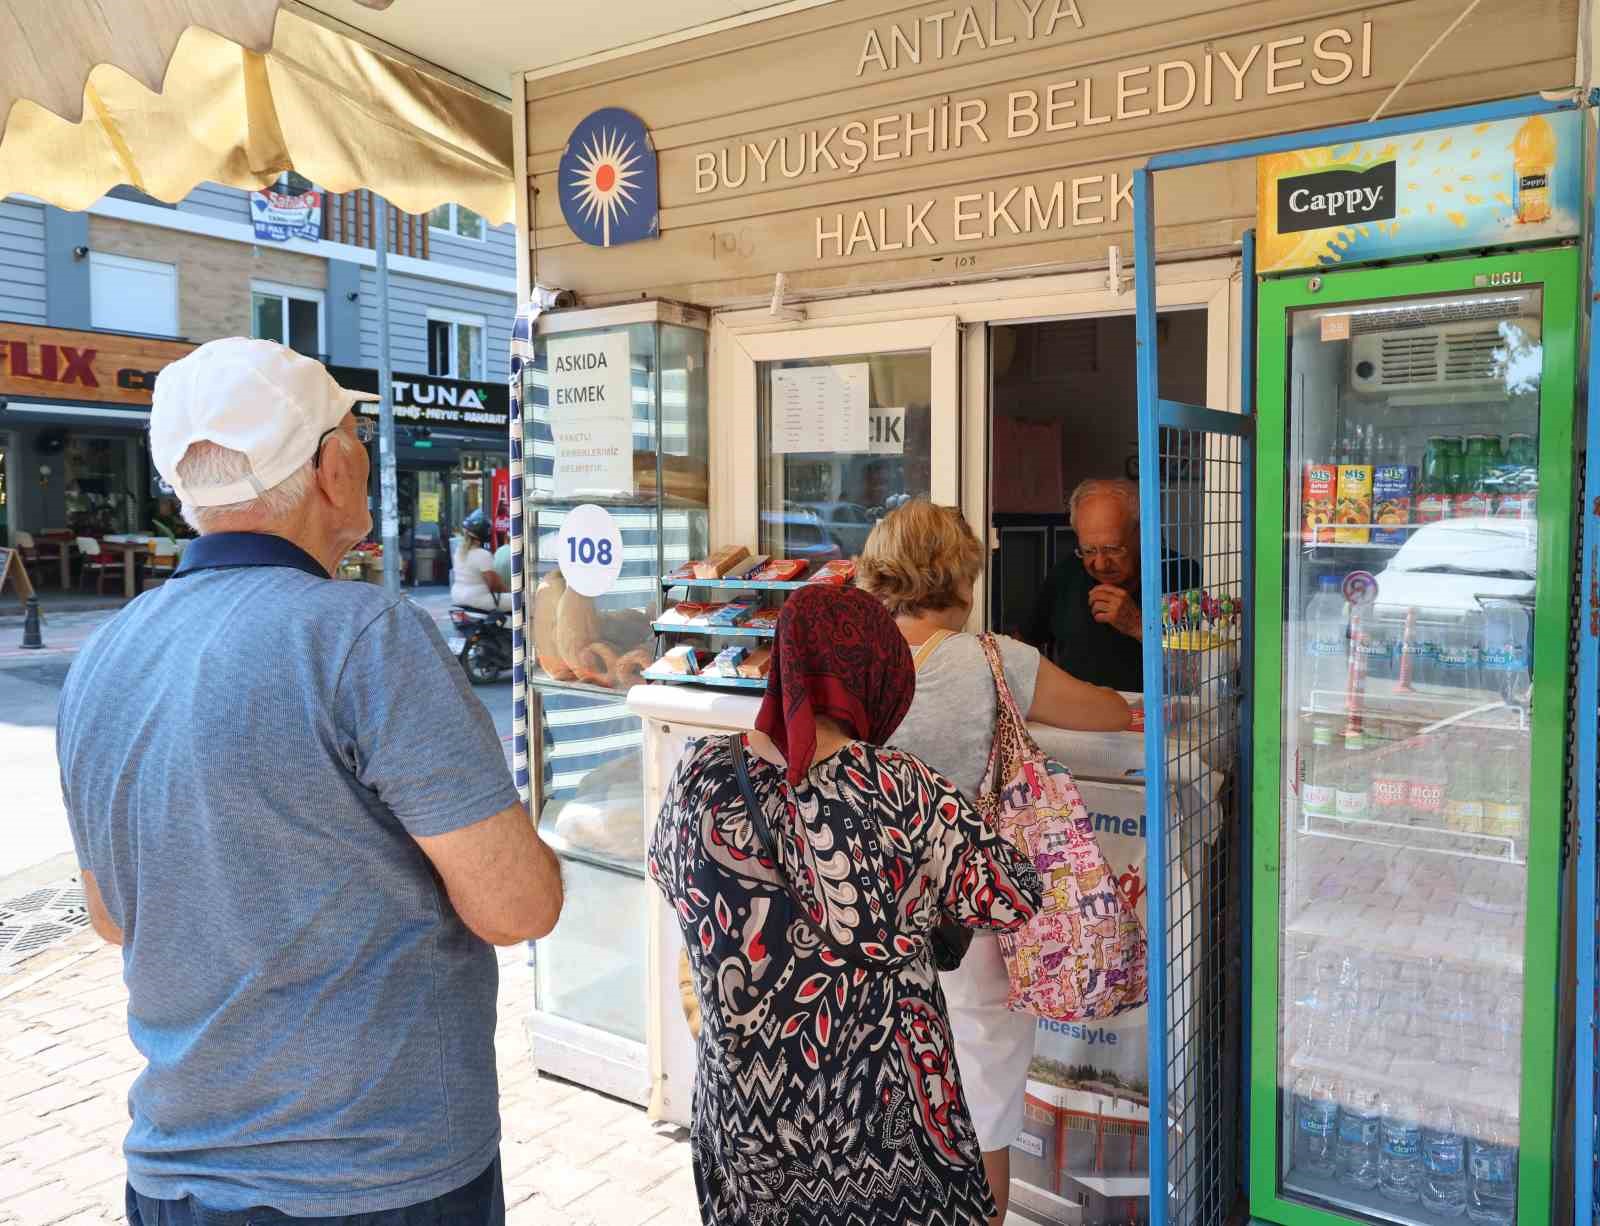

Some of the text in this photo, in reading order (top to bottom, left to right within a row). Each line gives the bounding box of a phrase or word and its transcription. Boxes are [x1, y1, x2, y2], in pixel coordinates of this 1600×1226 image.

[855, 0, 1085, 76] ANTALYA
[1289, 185, 1383, 216] Cappy
[815, 173, 1135, 258] HALK EKMEK
[556, 352, 607, 372] ASKIDA
[391, 381, 485, 409] TUNA
[557, 384, 605, 404] EKMEK
[567, 537, 612, 565] 108
